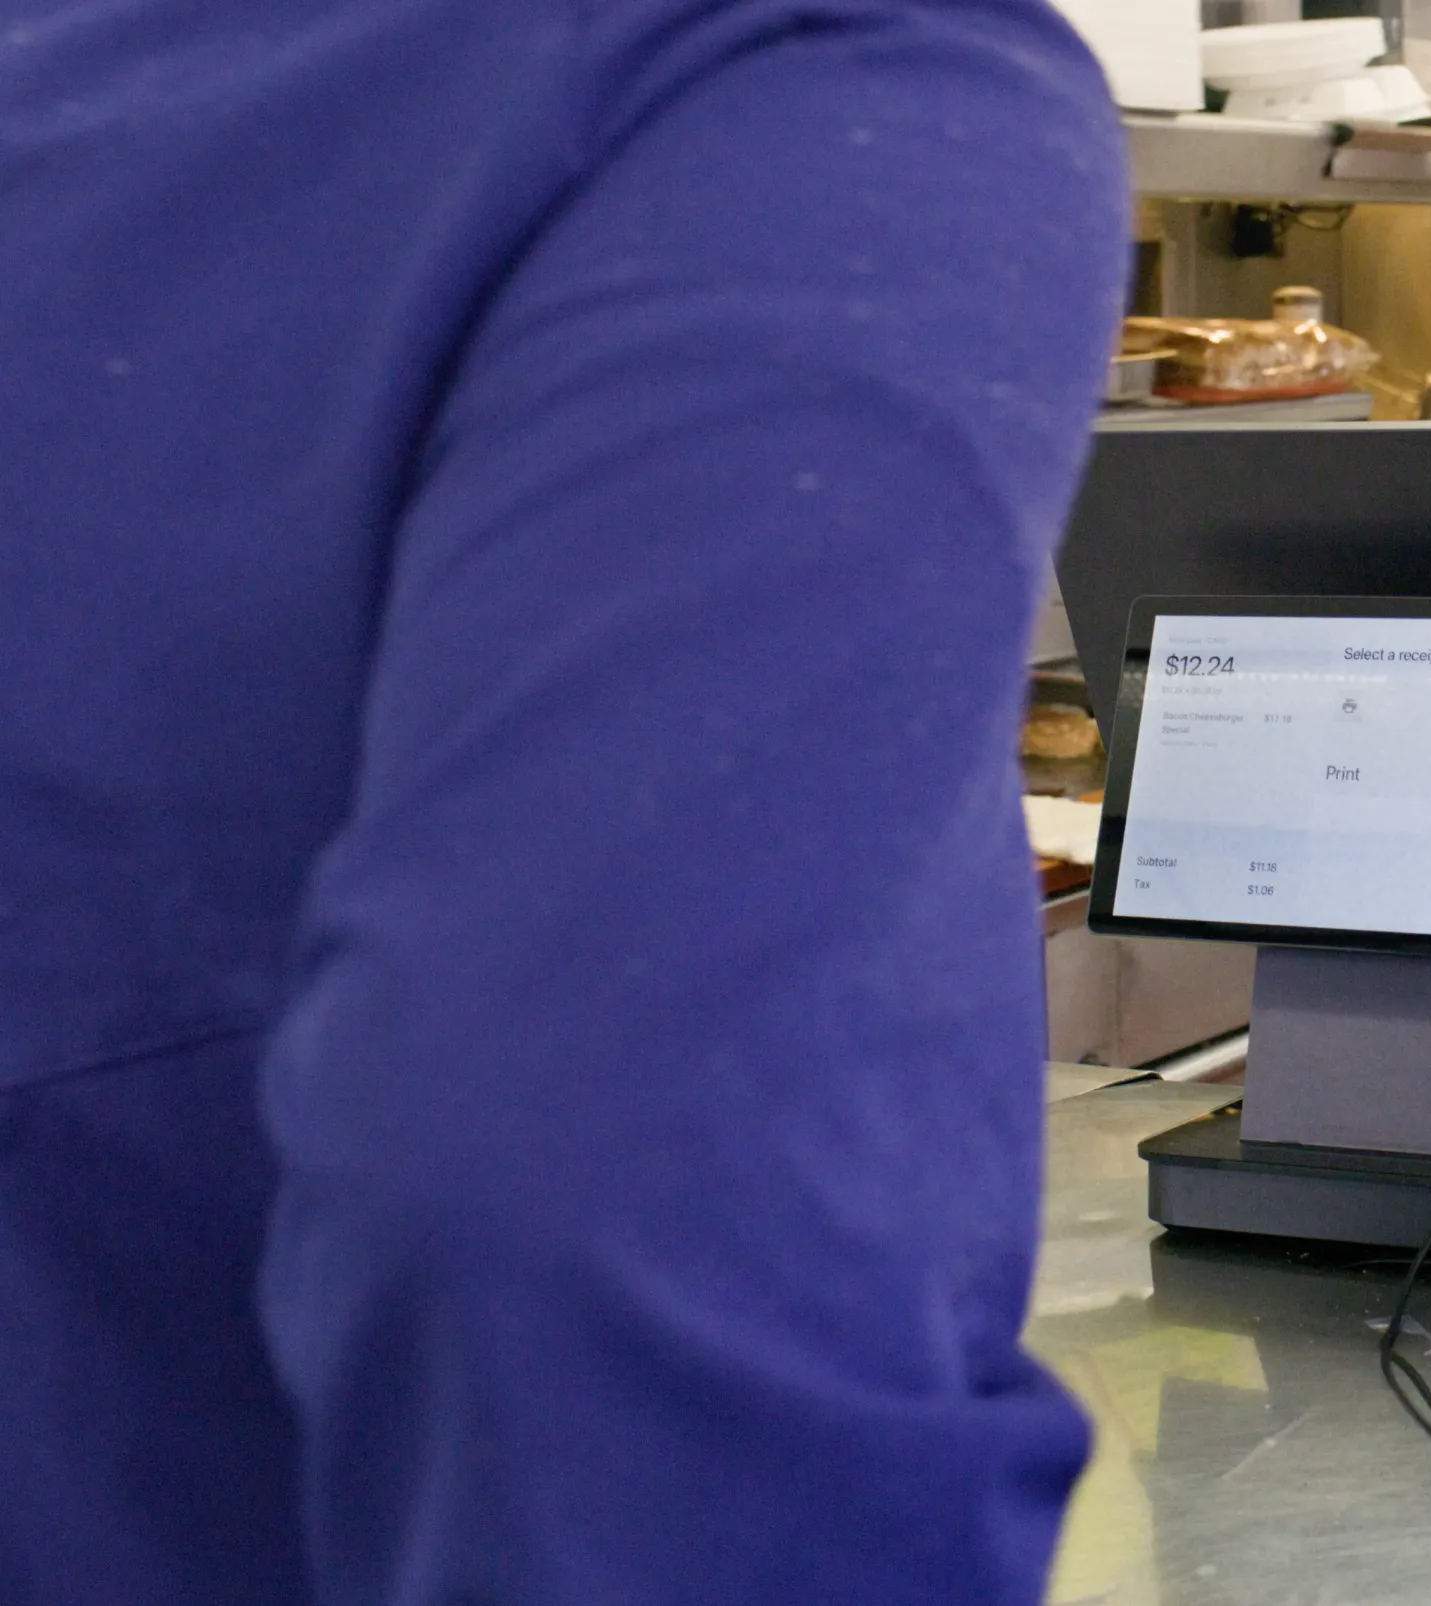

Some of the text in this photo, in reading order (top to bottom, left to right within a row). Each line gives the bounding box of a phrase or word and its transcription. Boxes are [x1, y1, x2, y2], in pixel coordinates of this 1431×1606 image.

[1344, 648, 1384, 661] Select
[1387, 651, 1395, 661] a
[1164, 653, 1235, 678] $12.24
[1326, 765, 1361, 781] Print
[1136, 856, 1178, 868] Subtotal
[1249, 861, 1277, 873] $11.18
[1134, 878, 1150, 889] Tax
[1247, 884, 1274, 896] $1.06
